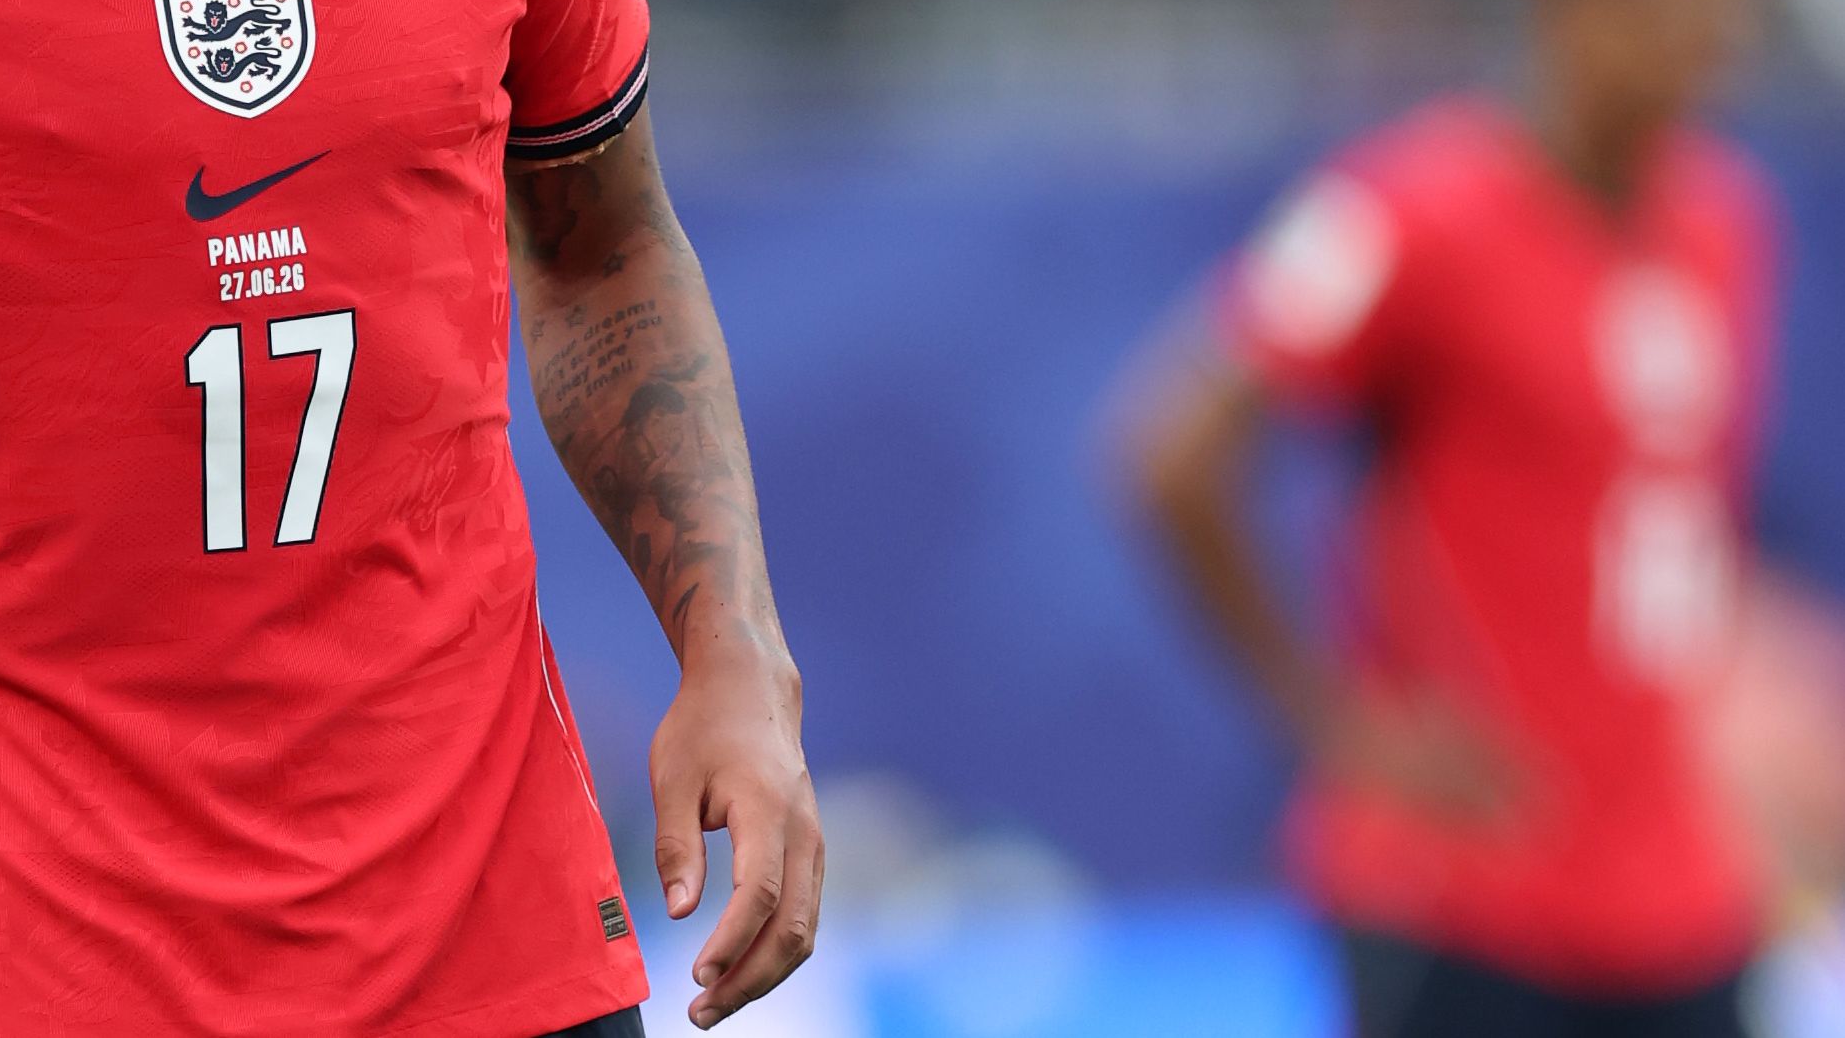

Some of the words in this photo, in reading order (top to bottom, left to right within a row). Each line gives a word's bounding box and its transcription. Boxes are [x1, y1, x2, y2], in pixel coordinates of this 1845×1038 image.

[207, 226, 307, 267] PANAMA
[219, 263, 305, 302] 27.06.26
[623, 314, 662, 340] you
[597, 343, 627, 370] are
[586, 358, 633, 399] small
[185, 308, 358, 553] 17
